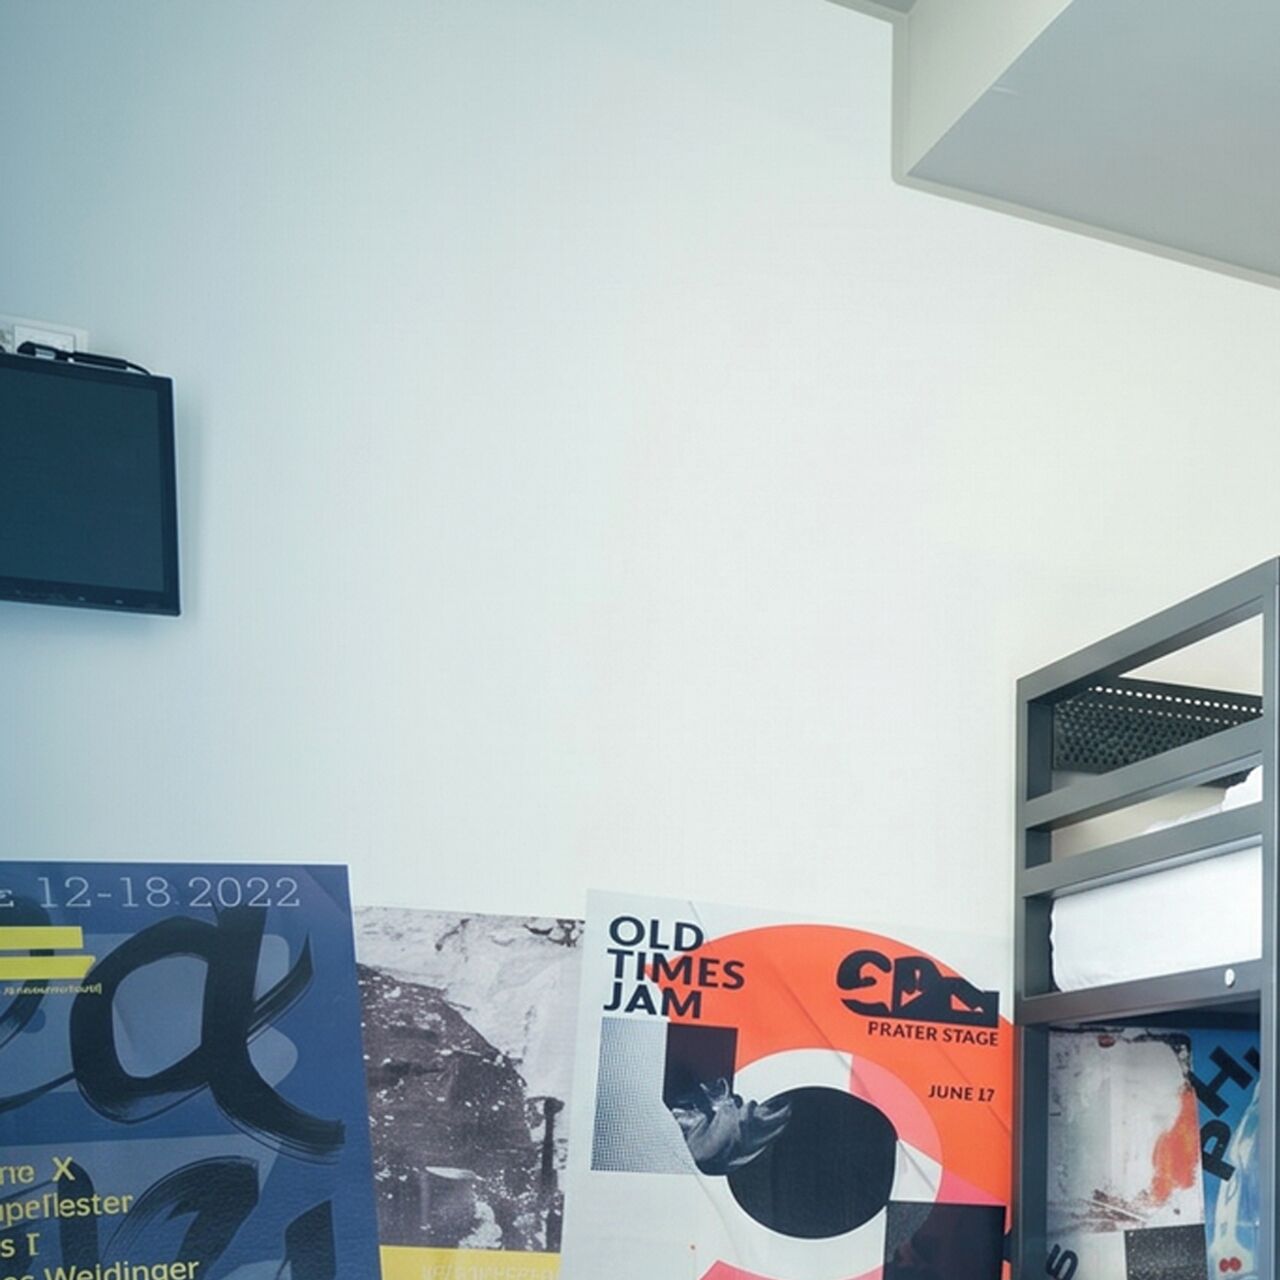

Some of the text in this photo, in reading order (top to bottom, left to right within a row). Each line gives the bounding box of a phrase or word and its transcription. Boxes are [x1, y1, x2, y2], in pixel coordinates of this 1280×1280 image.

[609, 916, 704, 952] OLD
[607, 948, 745, 990] TIMES
[603, 981, 702, 1019] JAM
[868, 1021, 998, 1046] PRATER STAGE
[928, 1085, 995, 1102] JUNE 17
